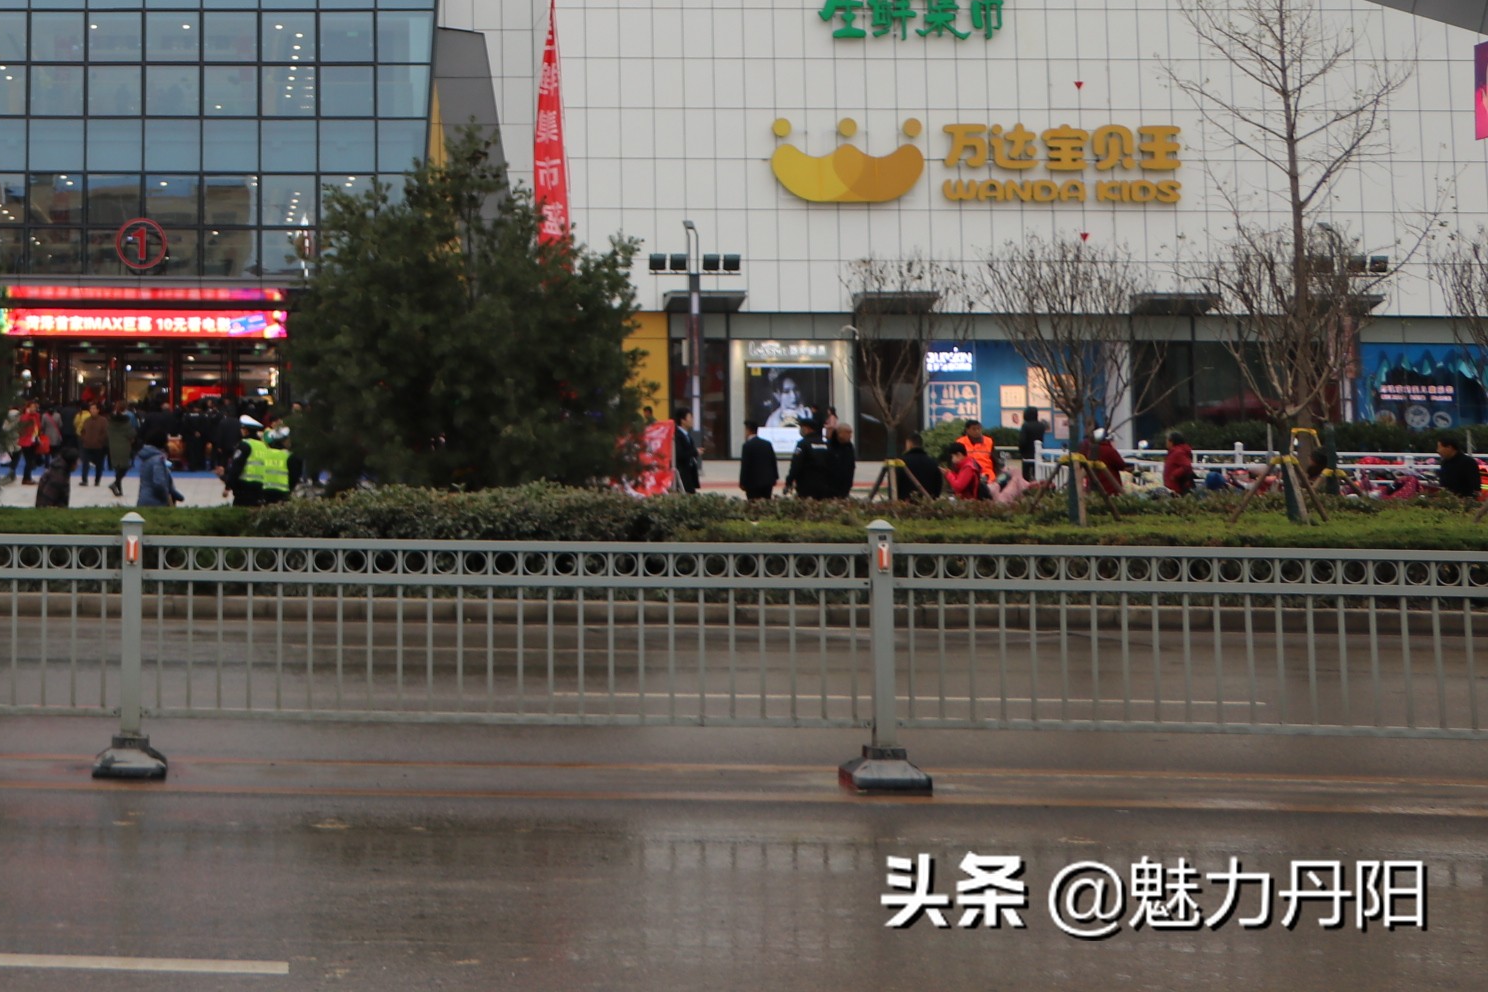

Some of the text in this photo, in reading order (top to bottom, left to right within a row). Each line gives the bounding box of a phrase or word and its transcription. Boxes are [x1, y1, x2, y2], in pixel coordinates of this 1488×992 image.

[943, 123, 1182, 171] 万达宝贝王
[943, 179, 1182, 203] WANDA KIDS
